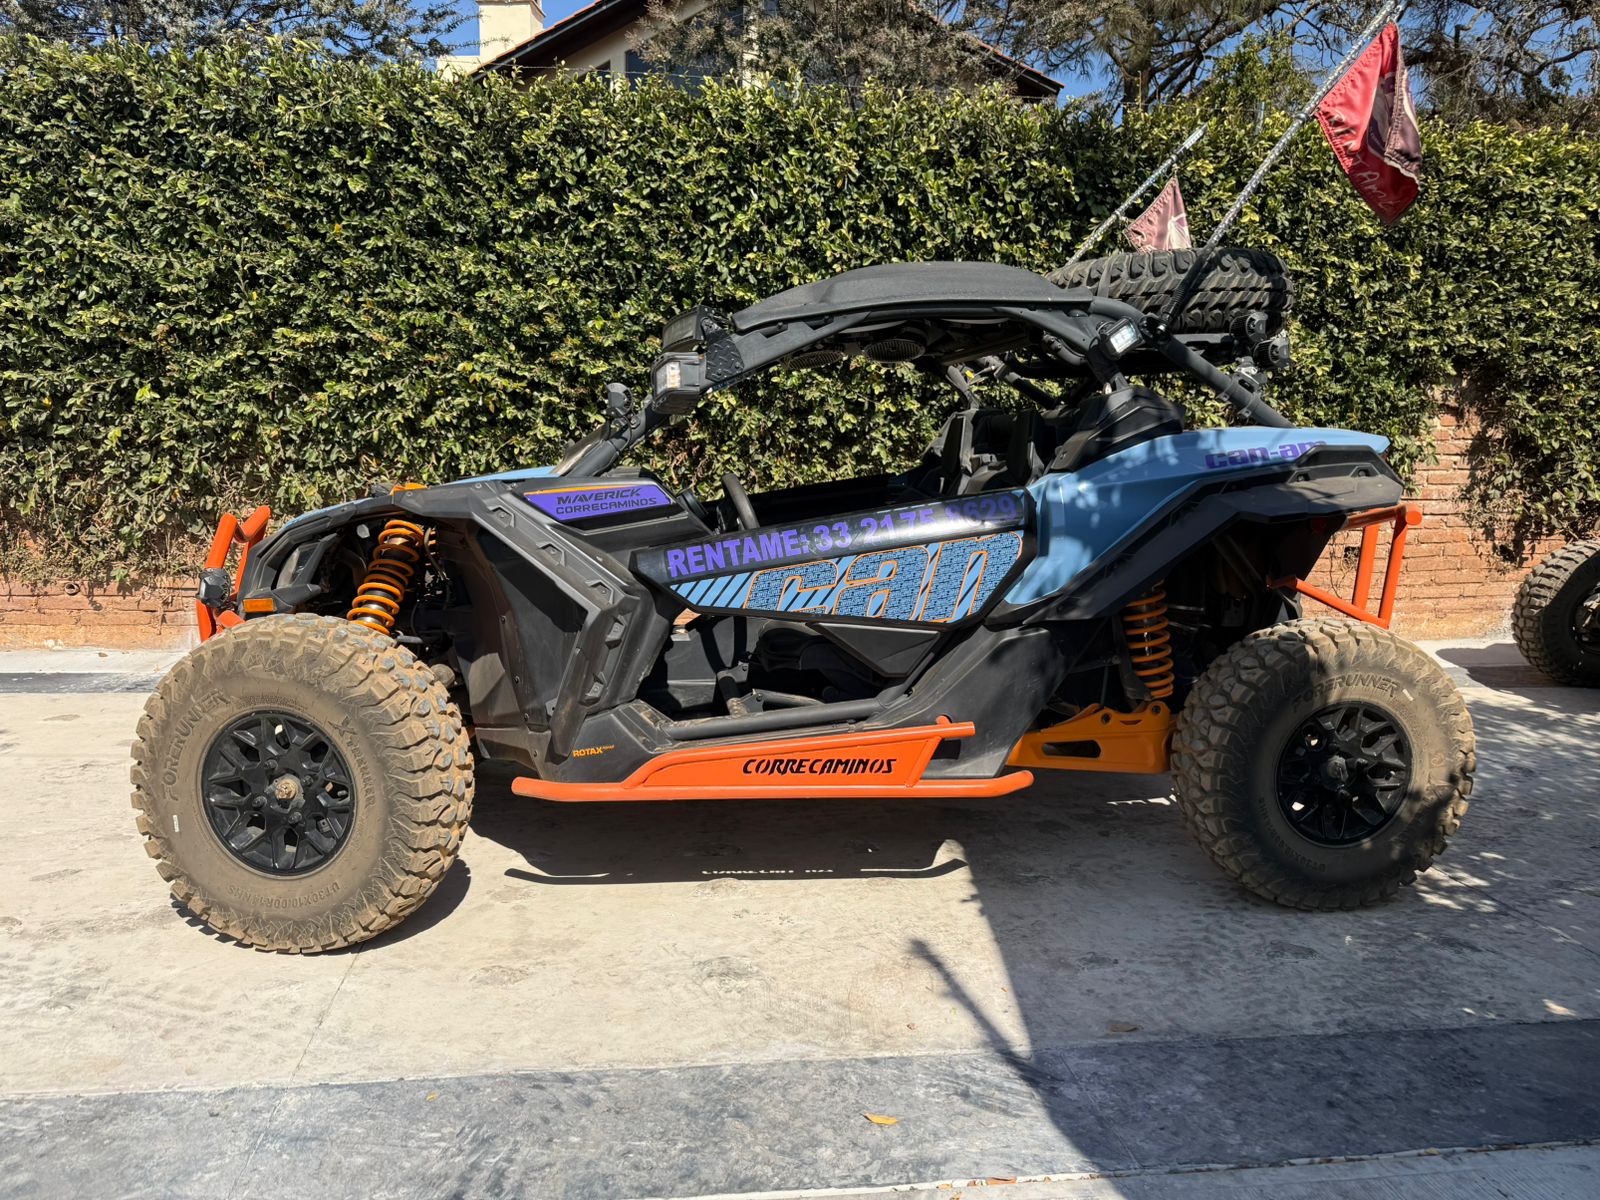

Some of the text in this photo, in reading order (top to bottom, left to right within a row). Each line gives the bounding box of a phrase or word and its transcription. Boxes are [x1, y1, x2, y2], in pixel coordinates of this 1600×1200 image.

[556, 487, 642, 505] MAVERICK
[556, 497, 657, 515] CORRECAMINOS
[667, 529, 810, 578] RENTAME:
[813, 524, 853, 552] 33
[572, 746, 603, 758] ROTAX
[742, 758, 897, 776] CORRECAMINOS
